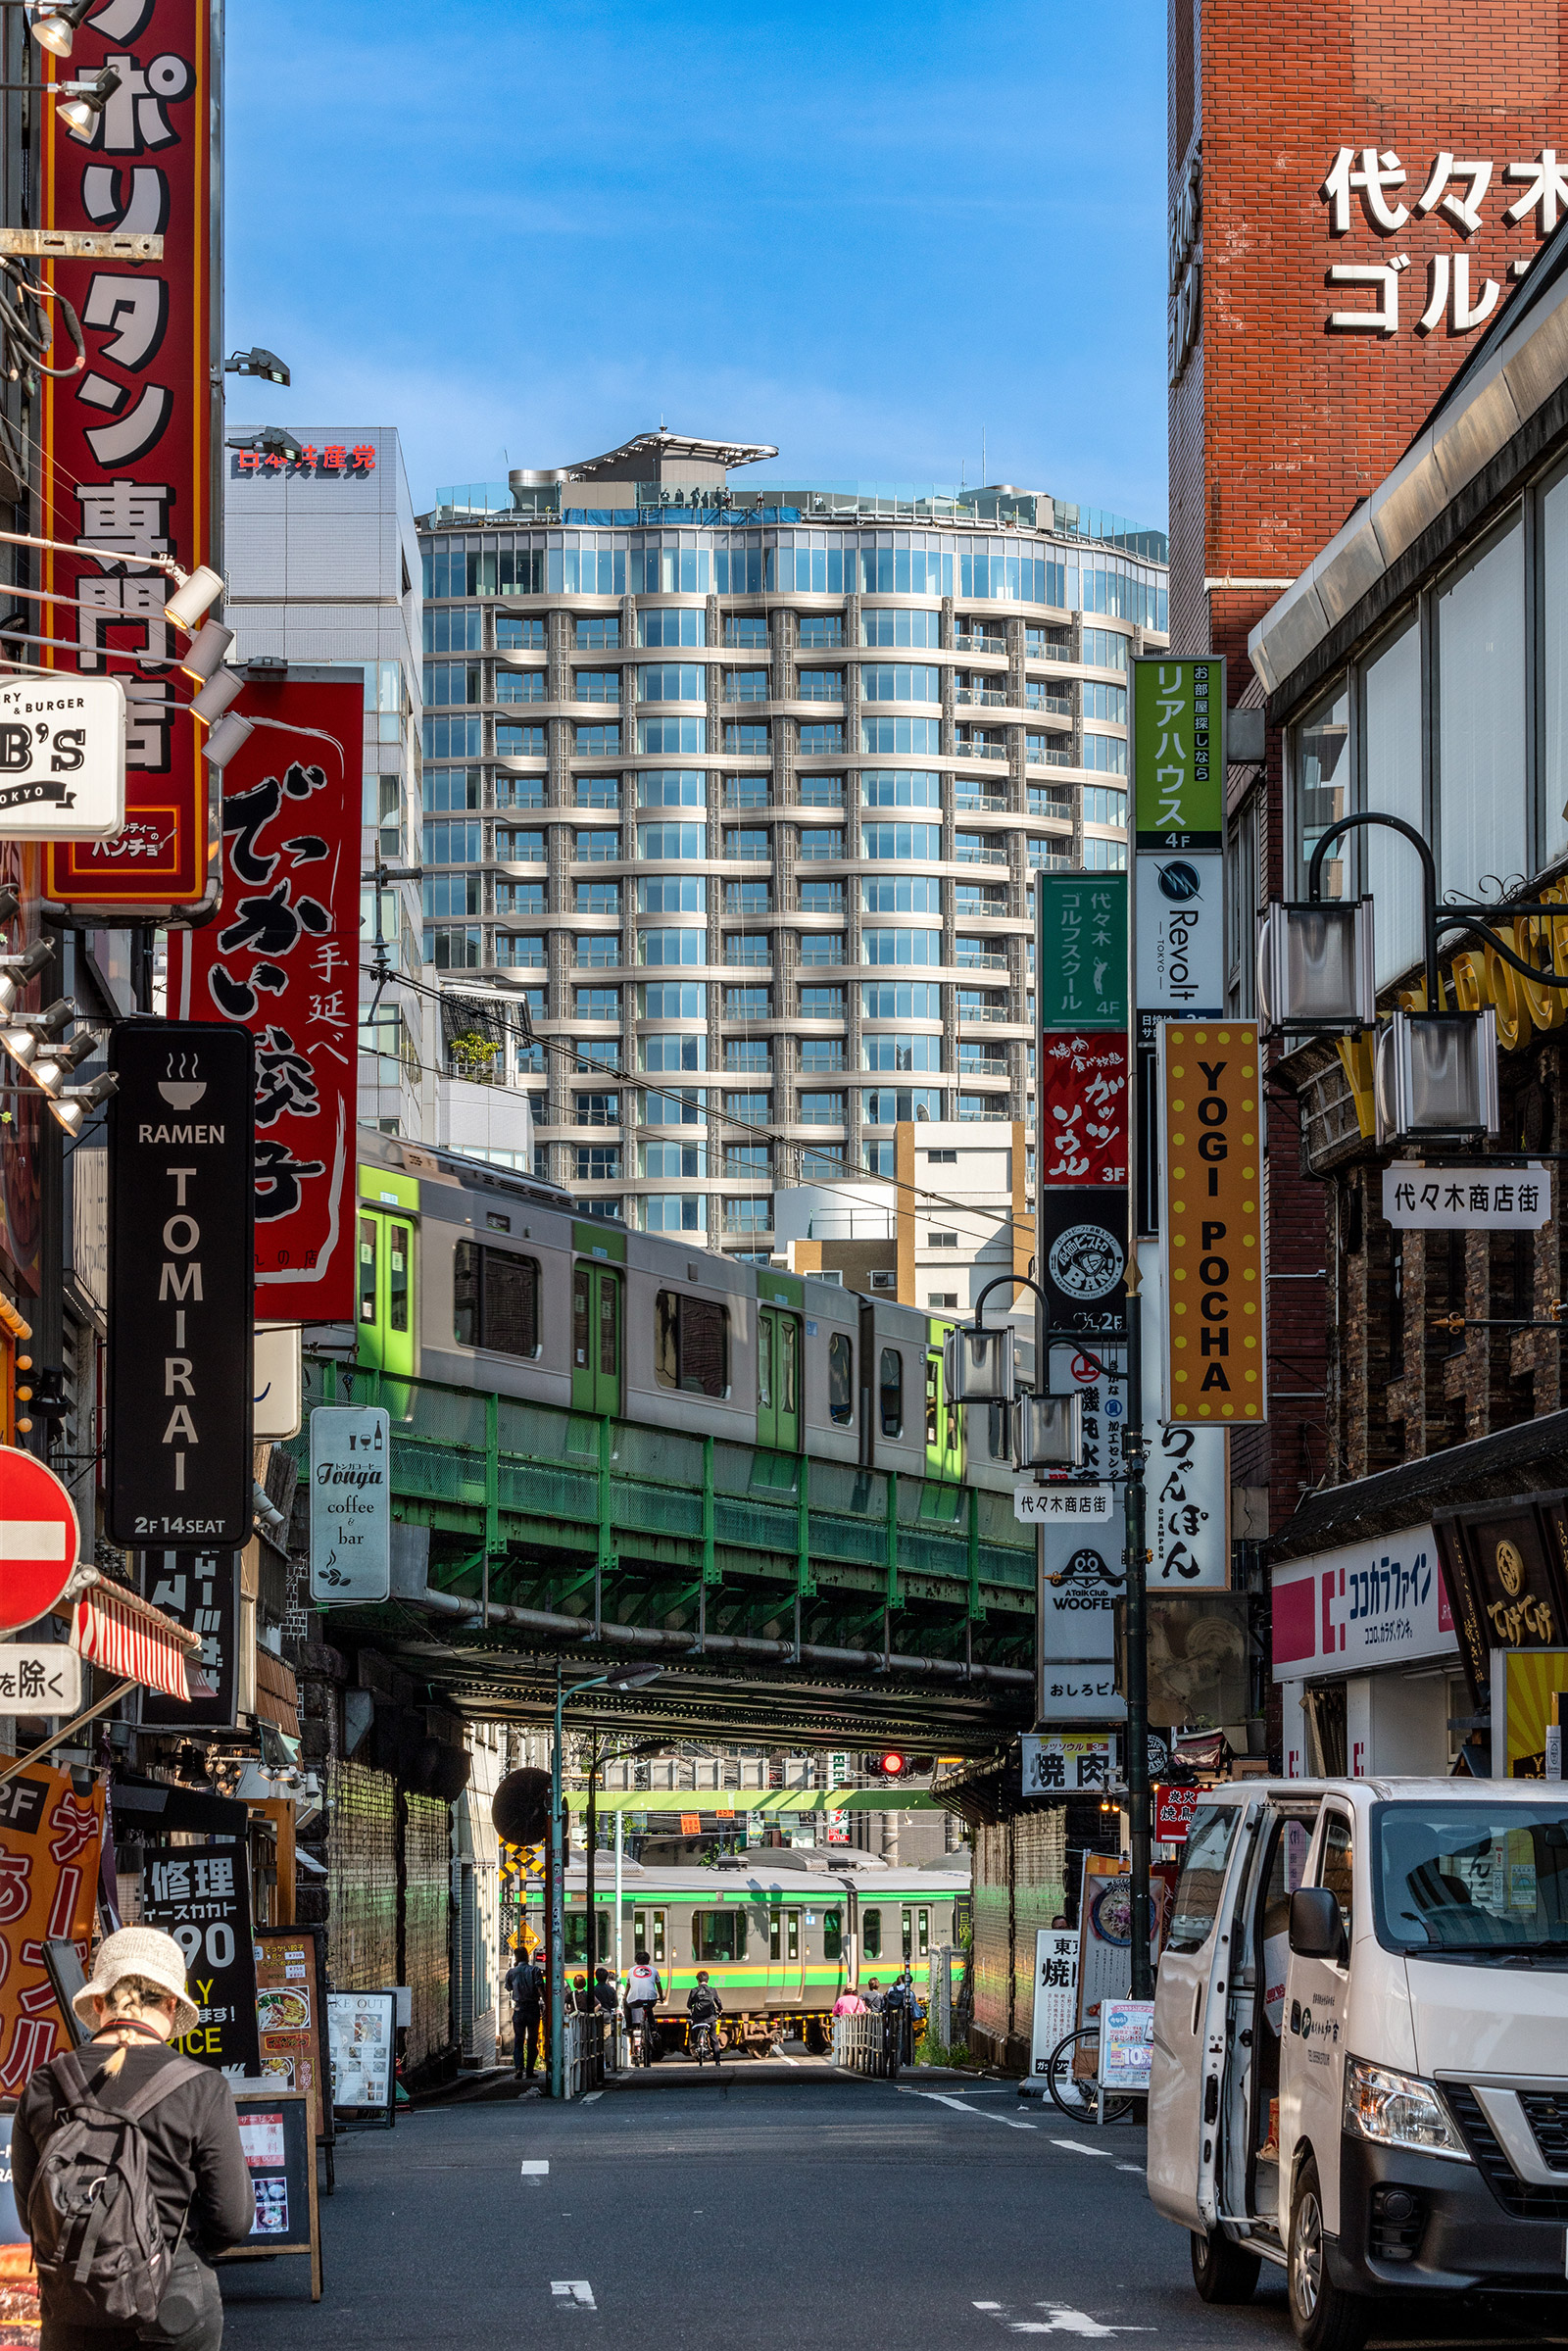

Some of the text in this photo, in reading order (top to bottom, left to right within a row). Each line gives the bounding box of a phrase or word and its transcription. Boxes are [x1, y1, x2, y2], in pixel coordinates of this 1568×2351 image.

[1325, 147, 1568, 233] 代々木
[1331, 253, 1533, 333] ゴル
[25, 698, 84, 713] BURGER
[1194, 665, 1209, 781] お部屋探しなら
[1154, 666, 1187, 826] リアハウス
[1164, 833, 1190, 848] 4F
[1091, 893, 1111, 946] 代々木
[1060, 893, 1081, 1010] ゴルフスクール
[1169, 910, 1200, 1001] Revolt
[306, 942, 351, 1065] 手延べ
[1097, 1002, 1120, 1014] 4F
[1085, 1072, 1125, 1149] ガッツ
[139, 1125, 224, 1144] RAMEN
[1049, 1104, 1090, 1176] ソウル
[1102, 1167, 1125, 1181] 3F
[1395, 1184, 1539, 1213] 代々木商店街
[1198, 1061, 1231, 1392] YOGI POCHA
[254, 1249, 318, 1267] の店
[159, 1167, 204, 1490] TOMIRAI
[317, 1462, 383, 1490] Tonga
[327, 1494, 374, 1513] coffee
[1021, 1495, 1106, 1513] 代々木商店街
[1158, 1427, 1208, 1579] ちゃんぽん
[134, 1519, 158, 1533] 2F
[338, 1527, 364, 1544] bar
[1349, 1553, 1431, 1620] ココカラファイン
[1030, 1753, 1109, 1788] 焼肉
[1168, 1790, 1195, 1804] 炭火
[143, 1858, 235, 1901] 修理
[162, 1922, 235, 1969] 90
[957, 1901, 970, 1948] 一旦停
[1041, 1958, 1077, 1987] 焼
[358, 1999, 385, 2008] OUT
